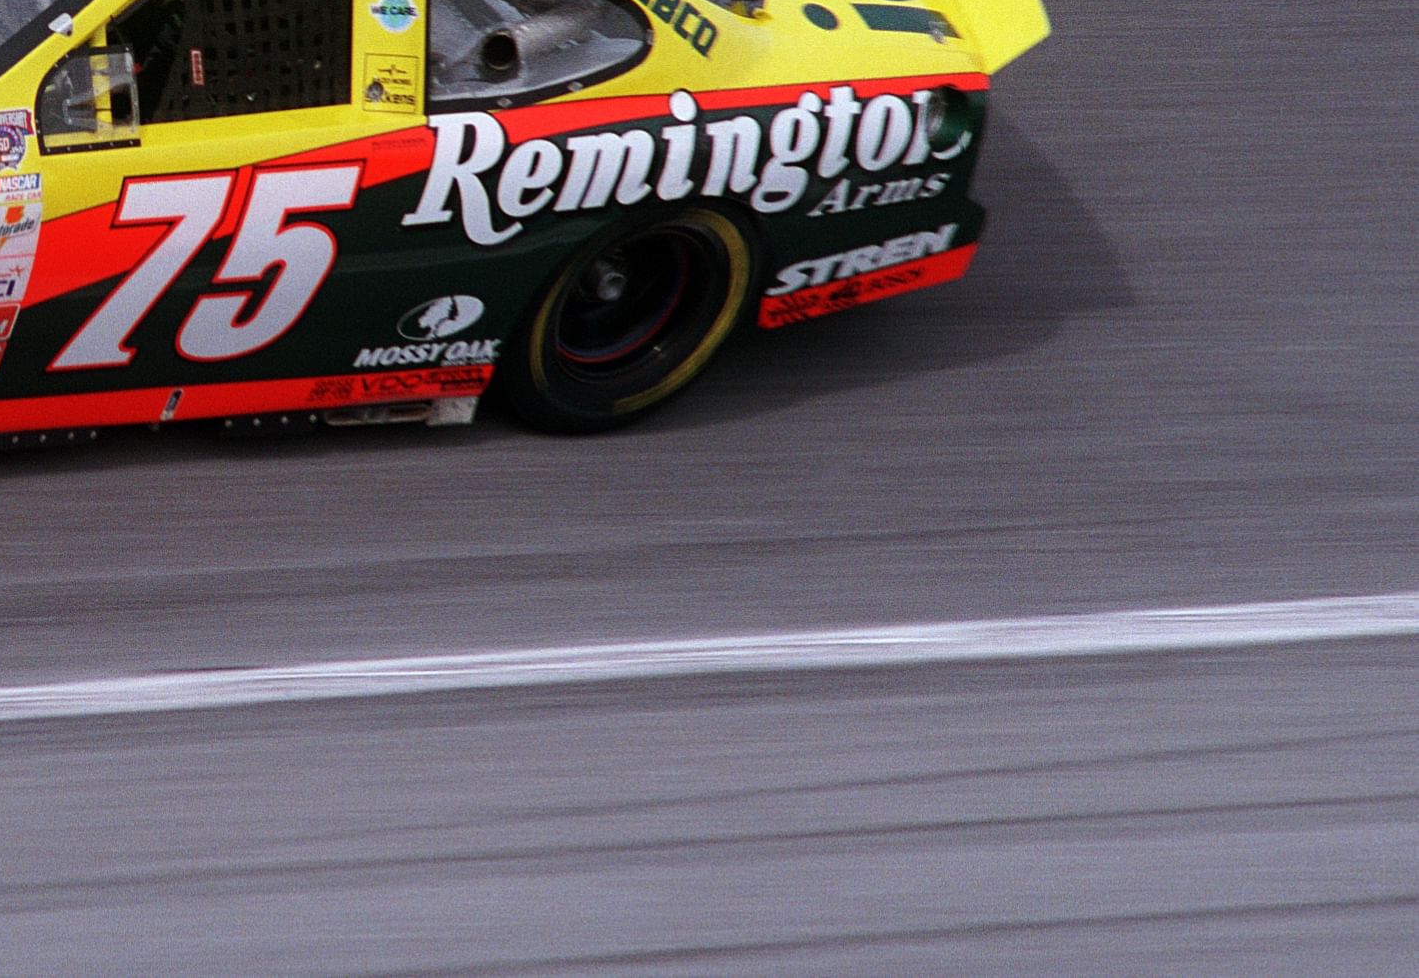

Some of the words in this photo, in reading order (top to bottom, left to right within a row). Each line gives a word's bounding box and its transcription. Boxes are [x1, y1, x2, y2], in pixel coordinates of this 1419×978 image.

[0, 175, 38, 191] NASCAR
[807, 173, 952, 217] Arms
[46, 159, 367, 373] 75
[764, 223, 959, 296] STREN
[353, 343, 445, 367] MOSSY
[445, 339, 501, 360] OAK
